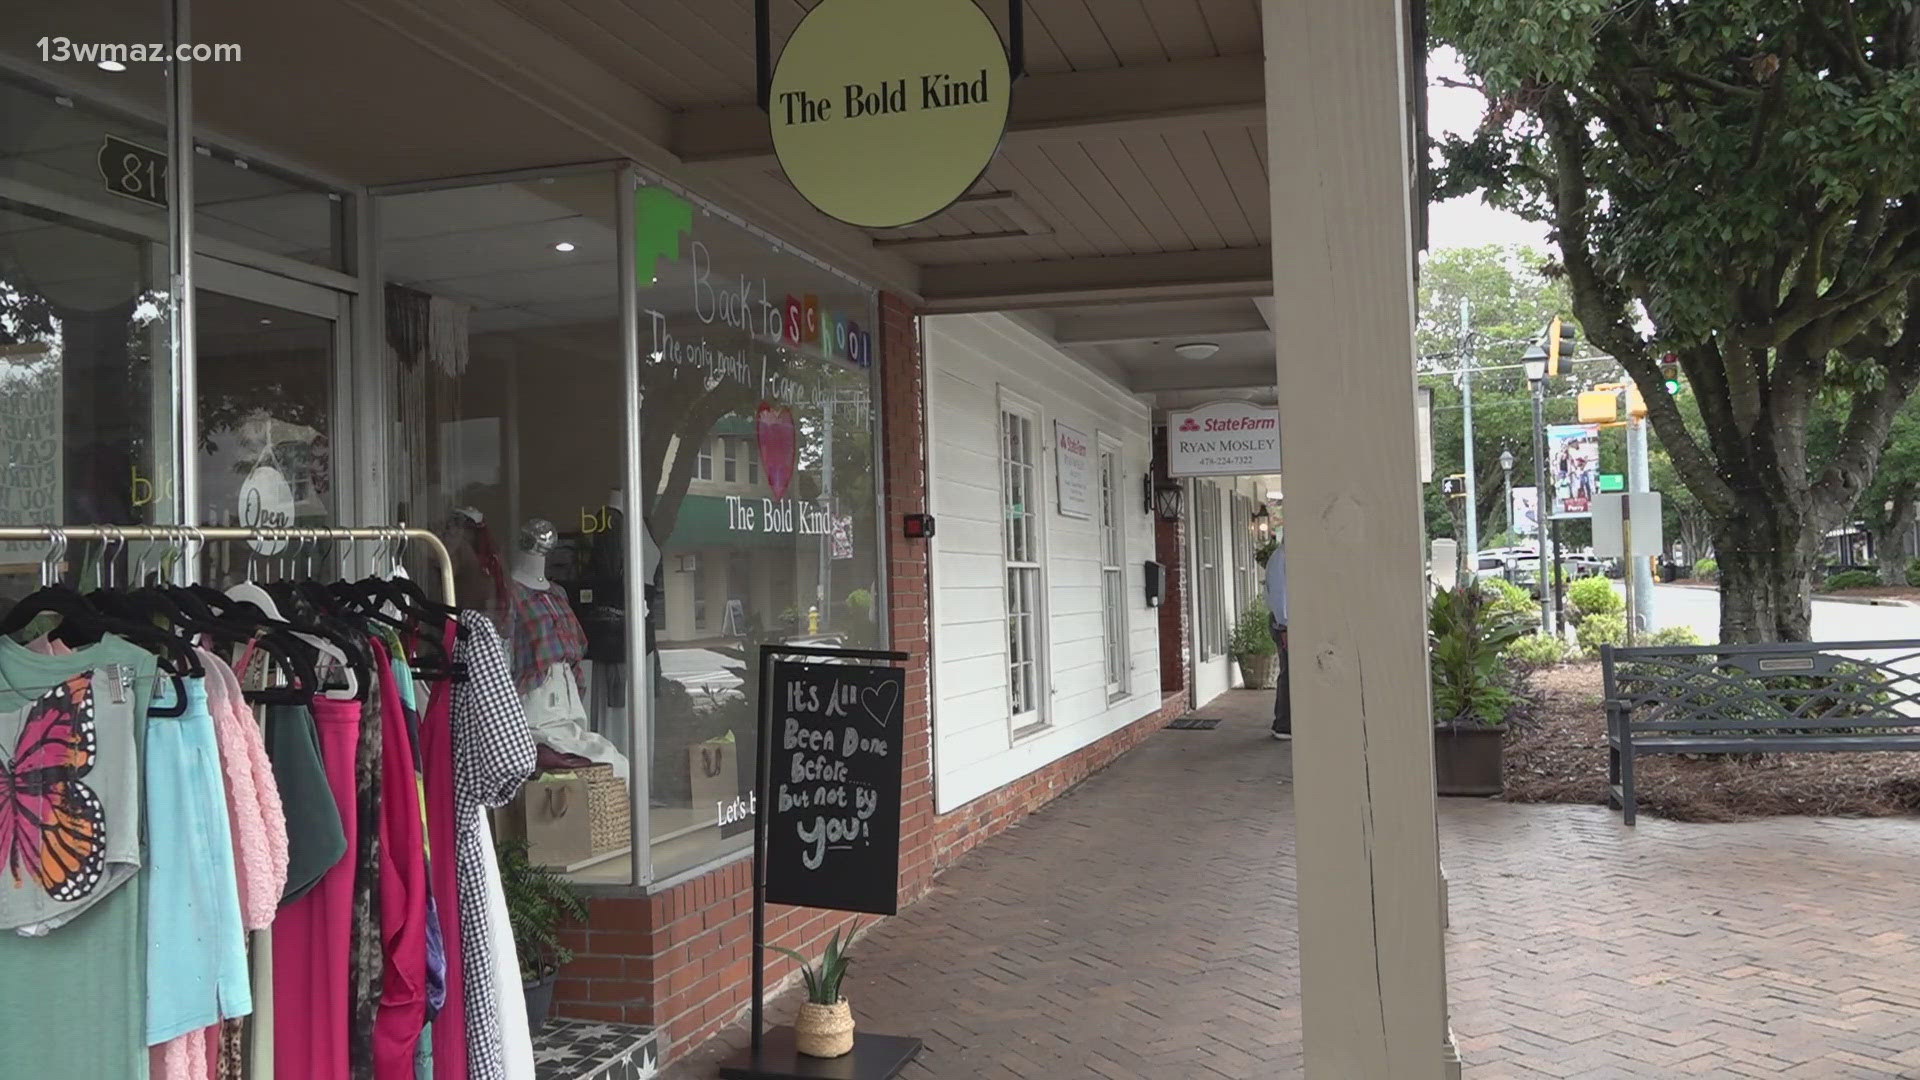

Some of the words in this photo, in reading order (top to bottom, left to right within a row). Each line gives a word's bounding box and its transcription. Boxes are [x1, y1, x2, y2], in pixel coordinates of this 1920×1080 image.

[779, 91, 832, 126] The
[843, 79, 907, 119] Bold
[920, 69, 988, 110] Kind
[691, 240, 755, 340] Back
[758, 277, 783, 343] to
[643, 308, 682, 364] The
[771, 371, 804, 405] care
[1180, 441, 1216, 453] RYAN
[1220, 439, 1275, 452] MOSLEY
[245, 487, 289, 528] Open
[726, 495, 755, 531] The
[762, 497, 793, 533] Bold
[798, 501, 831, 534] Kind
[787, 680, 820, 712] It's
[825, 678, 857, 717] All
[783, 717, 834, 751] Been
[842, 726, 888, 758] Done
[717, 796, 746, 827] Let's
[814, 786, 848, 808] not
